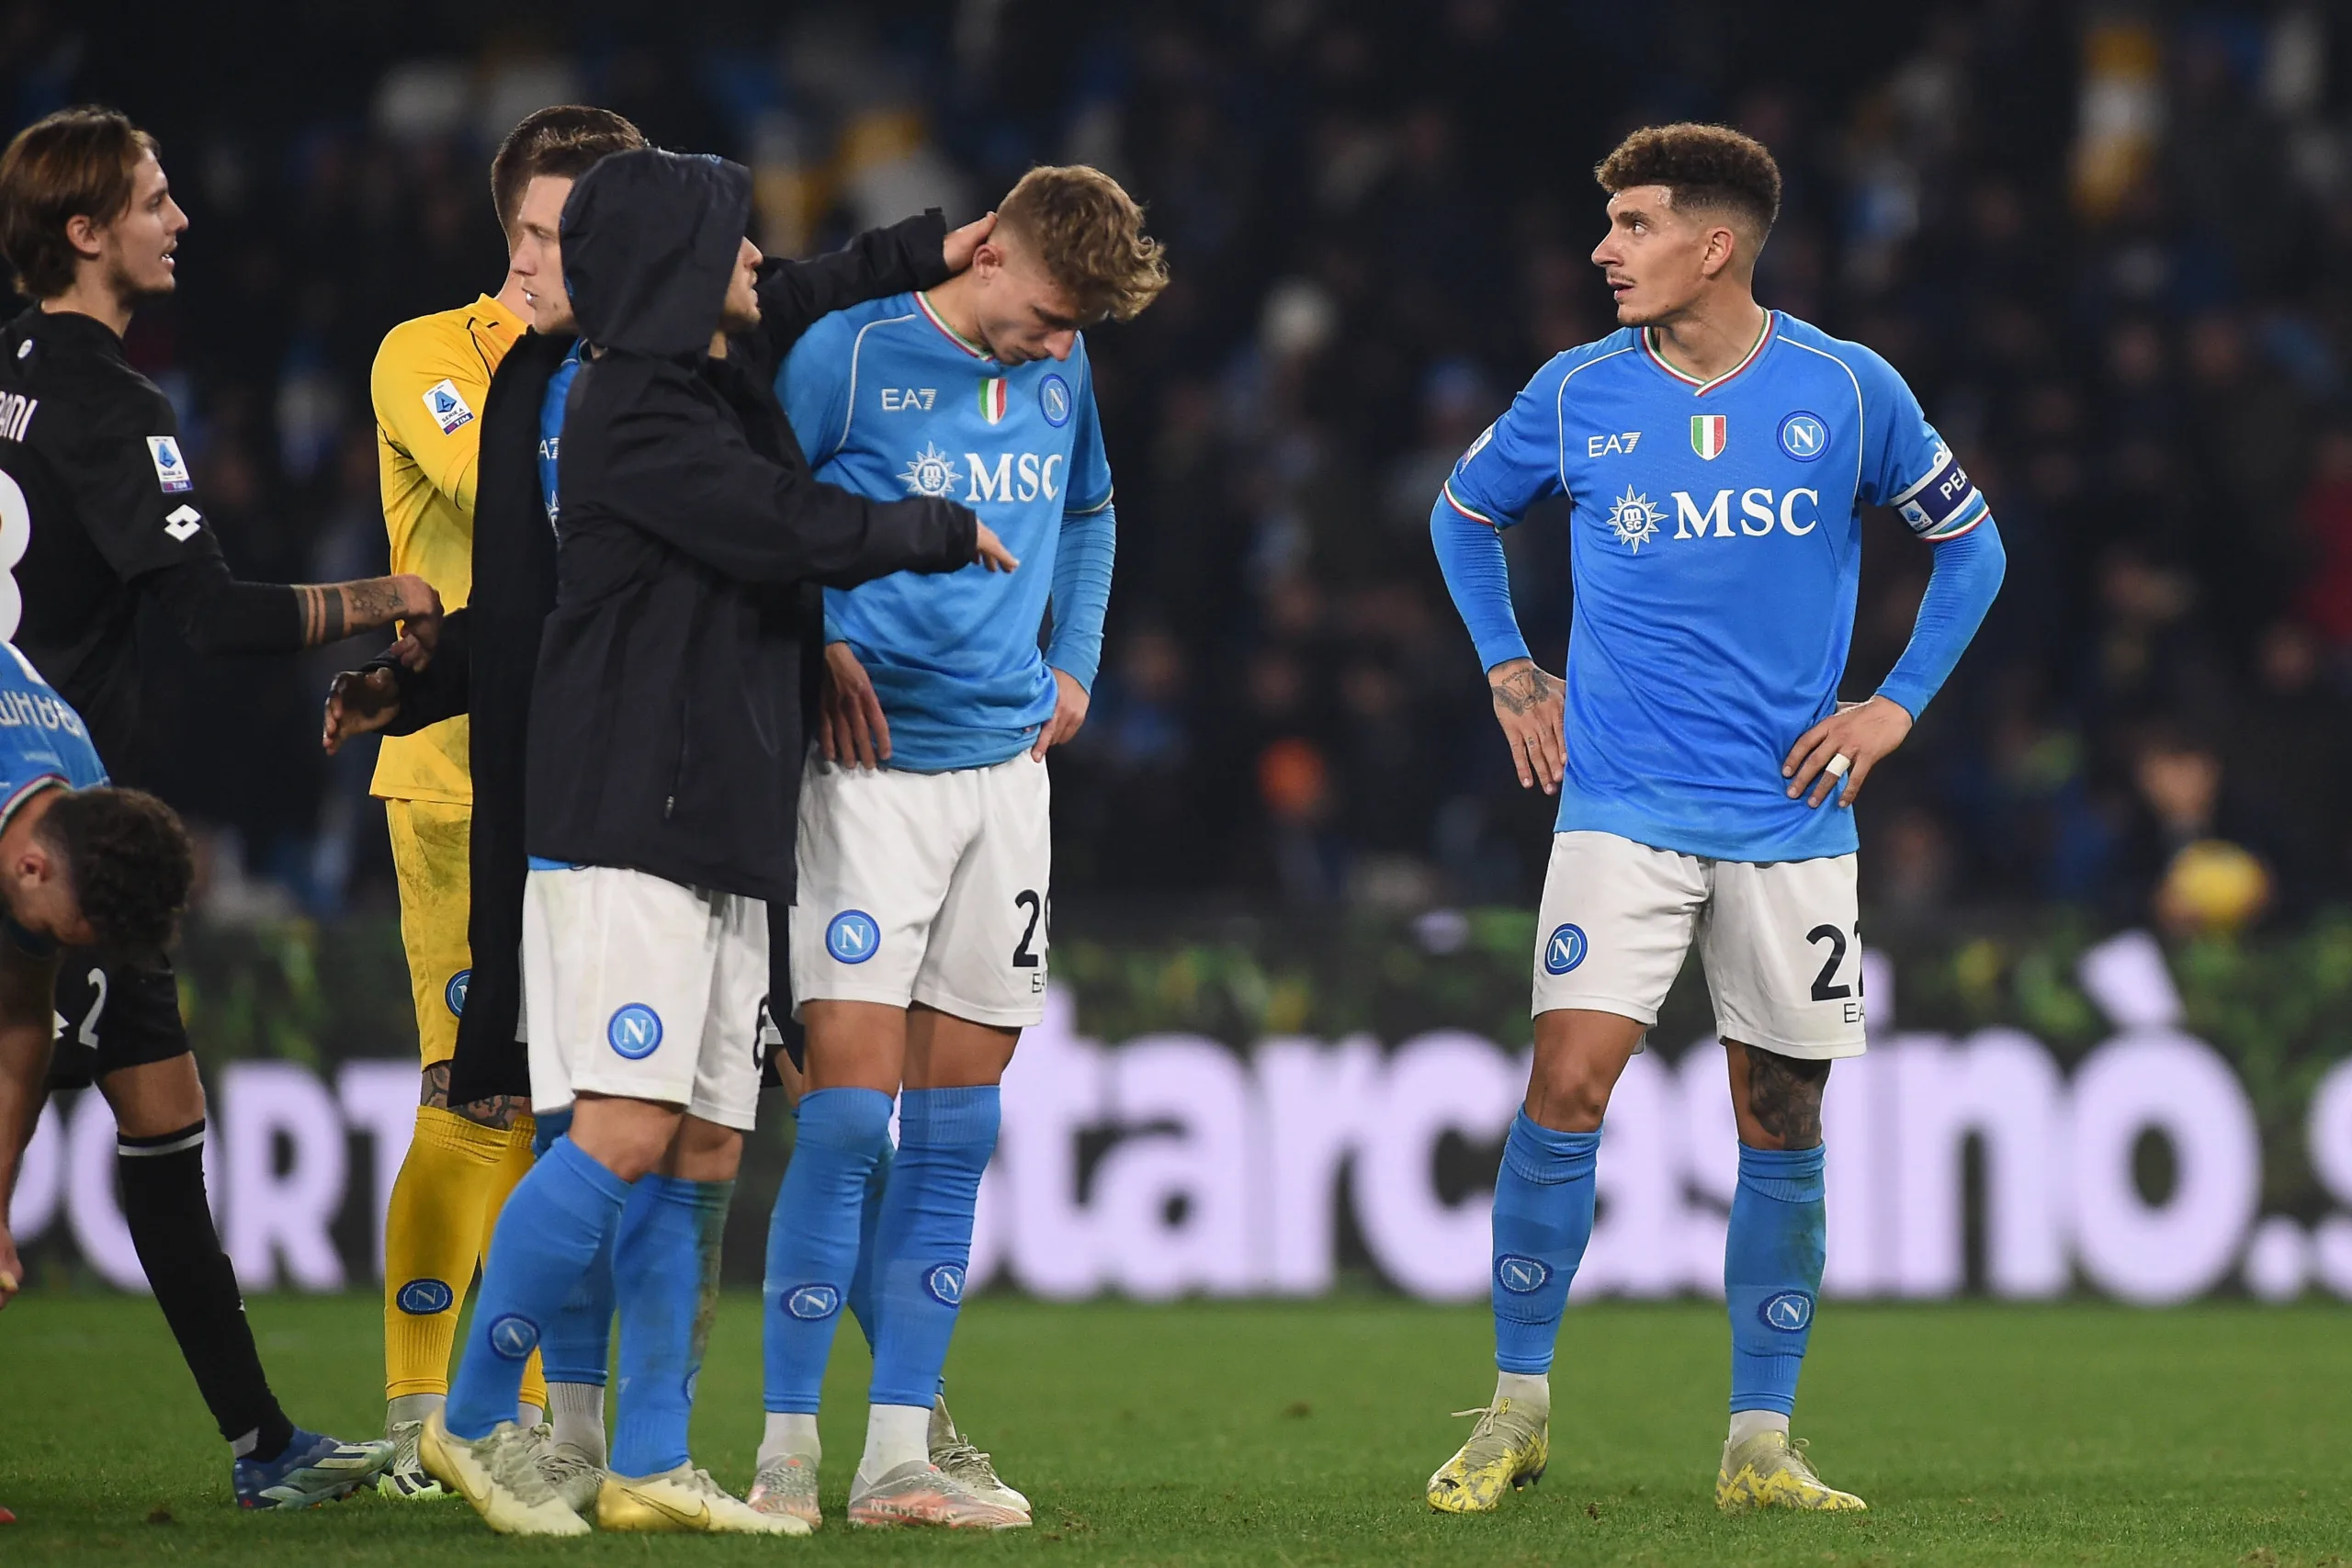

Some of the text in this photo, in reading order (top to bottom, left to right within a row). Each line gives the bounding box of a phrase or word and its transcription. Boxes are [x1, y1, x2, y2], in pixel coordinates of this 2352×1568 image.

[881, 389, 937, 411] EA7
[1048, 387, 1065, 412] N
[1588, 431, 1642, 457] EA7
[1792, 424, 1815, 448] N
[965, 453, 1063, 502] MSC
[1670, 488, 1818, 540] MSC
[840, 923, 864, 950] N
[1551, 936, 1575, 962] N
[78, 967, 107, 1050] 2
[623, 1018, 648, 1045] N
[940, 1271, 961, 1296] N
[1508, 1264, 1532, 1284] N
[415, 1288, 436, 1304] N
[802, 1292, 829, 1312] N
[1777, 1302, 1804, 1323] N
